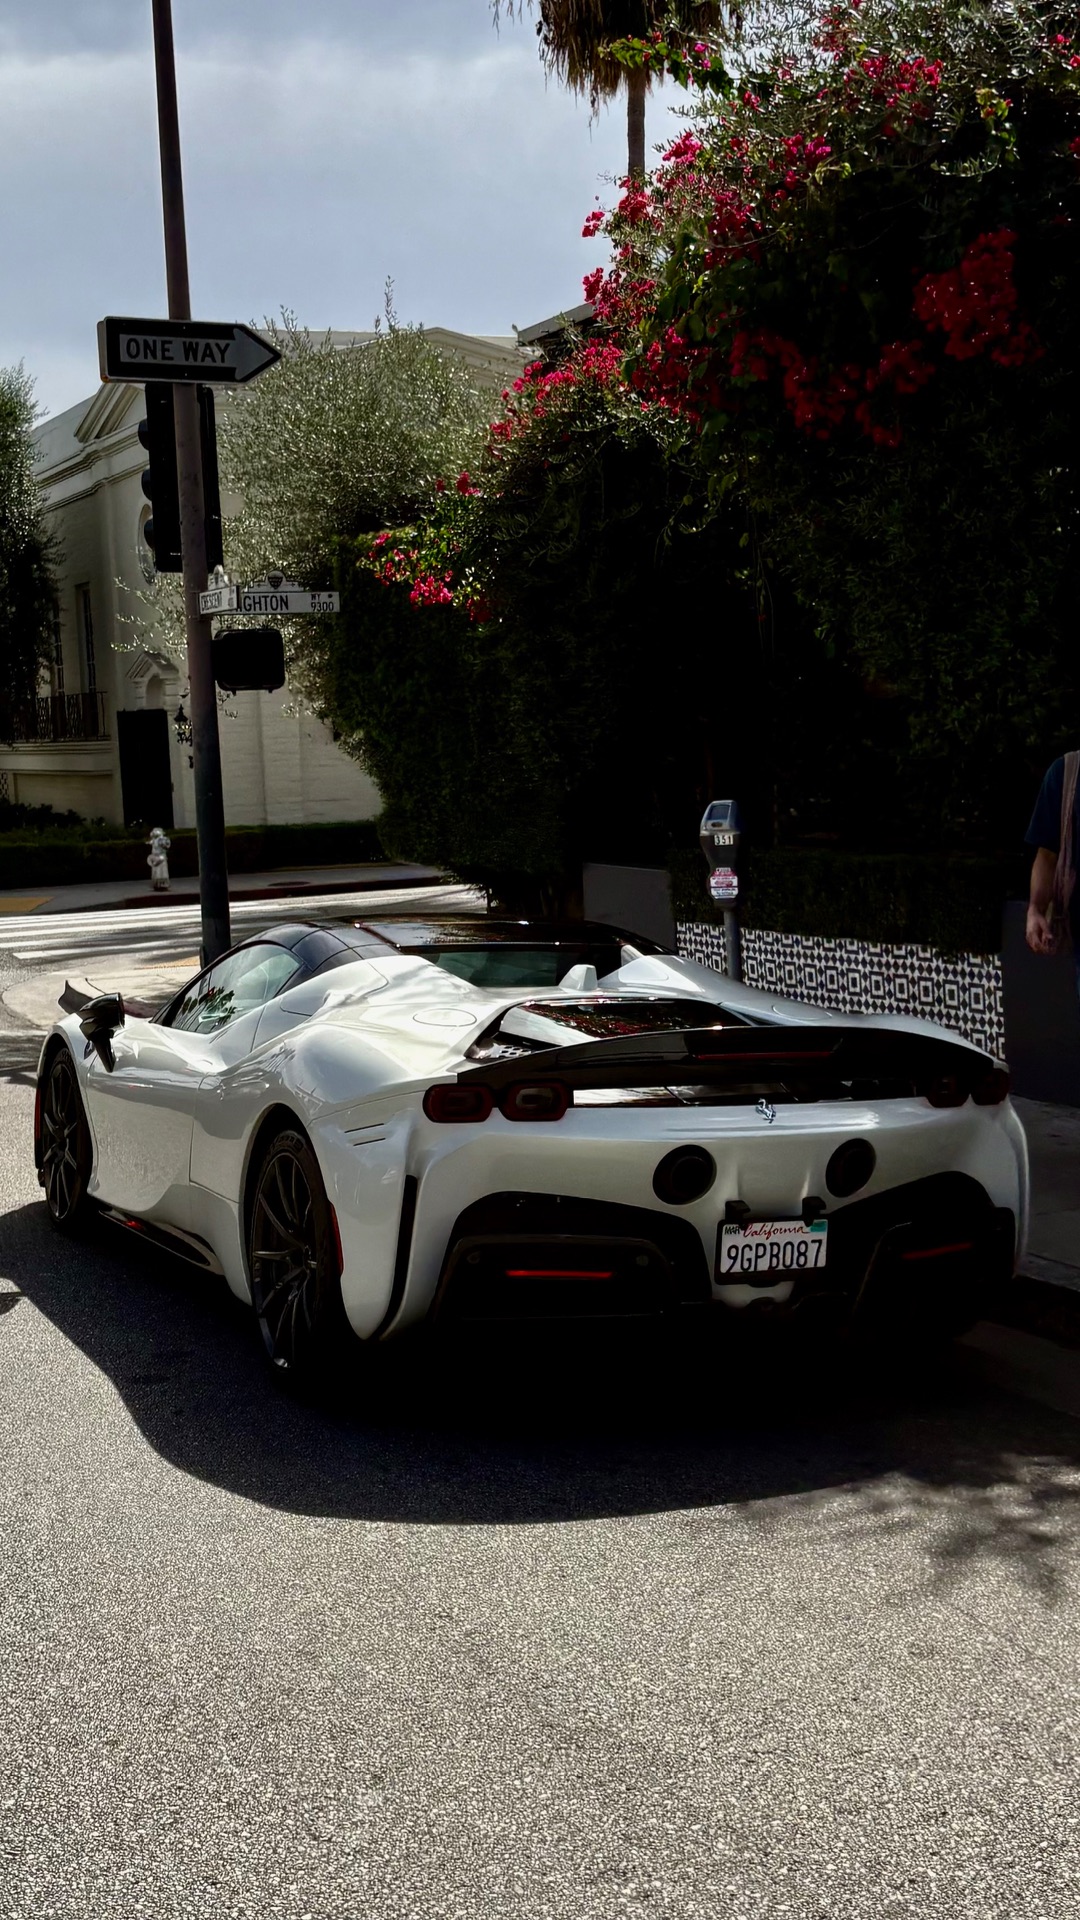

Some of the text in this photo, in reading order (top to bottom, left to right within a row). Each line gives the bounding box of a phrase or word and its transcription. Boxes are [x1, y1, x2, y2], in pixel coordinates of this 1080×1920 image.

[126, 338, 231, 364] ONE WAY
[236, 595, 289, 612] GHTON
[310, 602, 335, 612] 9300
[715, 835, 732, 845] 351
[742, 1222, 811, 1241] California
[726, 1239, 823, 1274] 9GPB087
